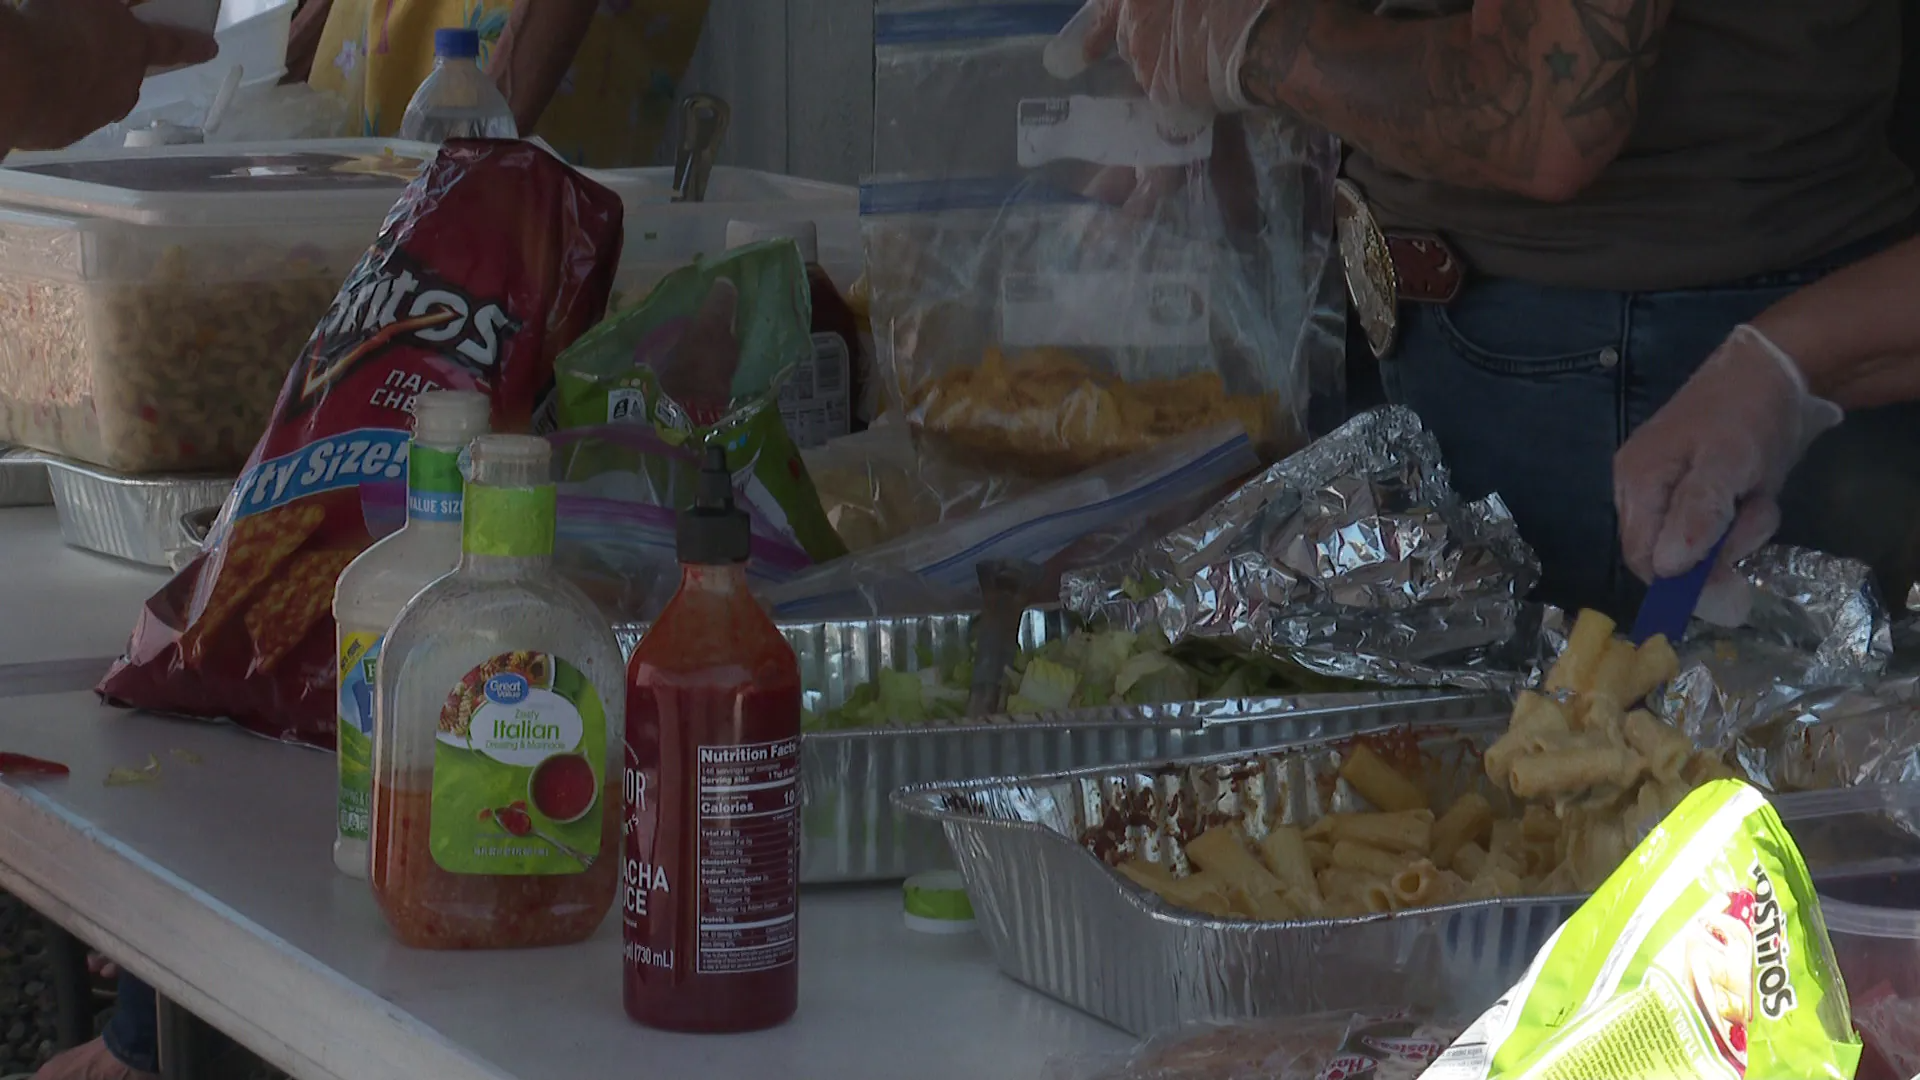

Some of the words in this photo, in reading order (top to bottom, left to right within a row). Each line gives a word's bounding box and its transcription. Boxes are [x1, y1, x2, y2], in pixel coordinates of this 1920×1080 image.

[301, 440, 408, 486] Size!
[410, 496, 437, 513] VALUE
[490, 679, 521, 692] Great
[497, 689, 521, 698] Value
[515, 708, 540, 721] Zesty
[493, 719, 559, 739] Italian
[486, 740, 518, 751] Dressing
[701, 747, 768, 763] Nutrition
[701, 776, 733, 786] Serving
[734, 775, 750, 784] size
[701, 800, 754, 813] Calories
[653, 948, 674, 970] mL)
